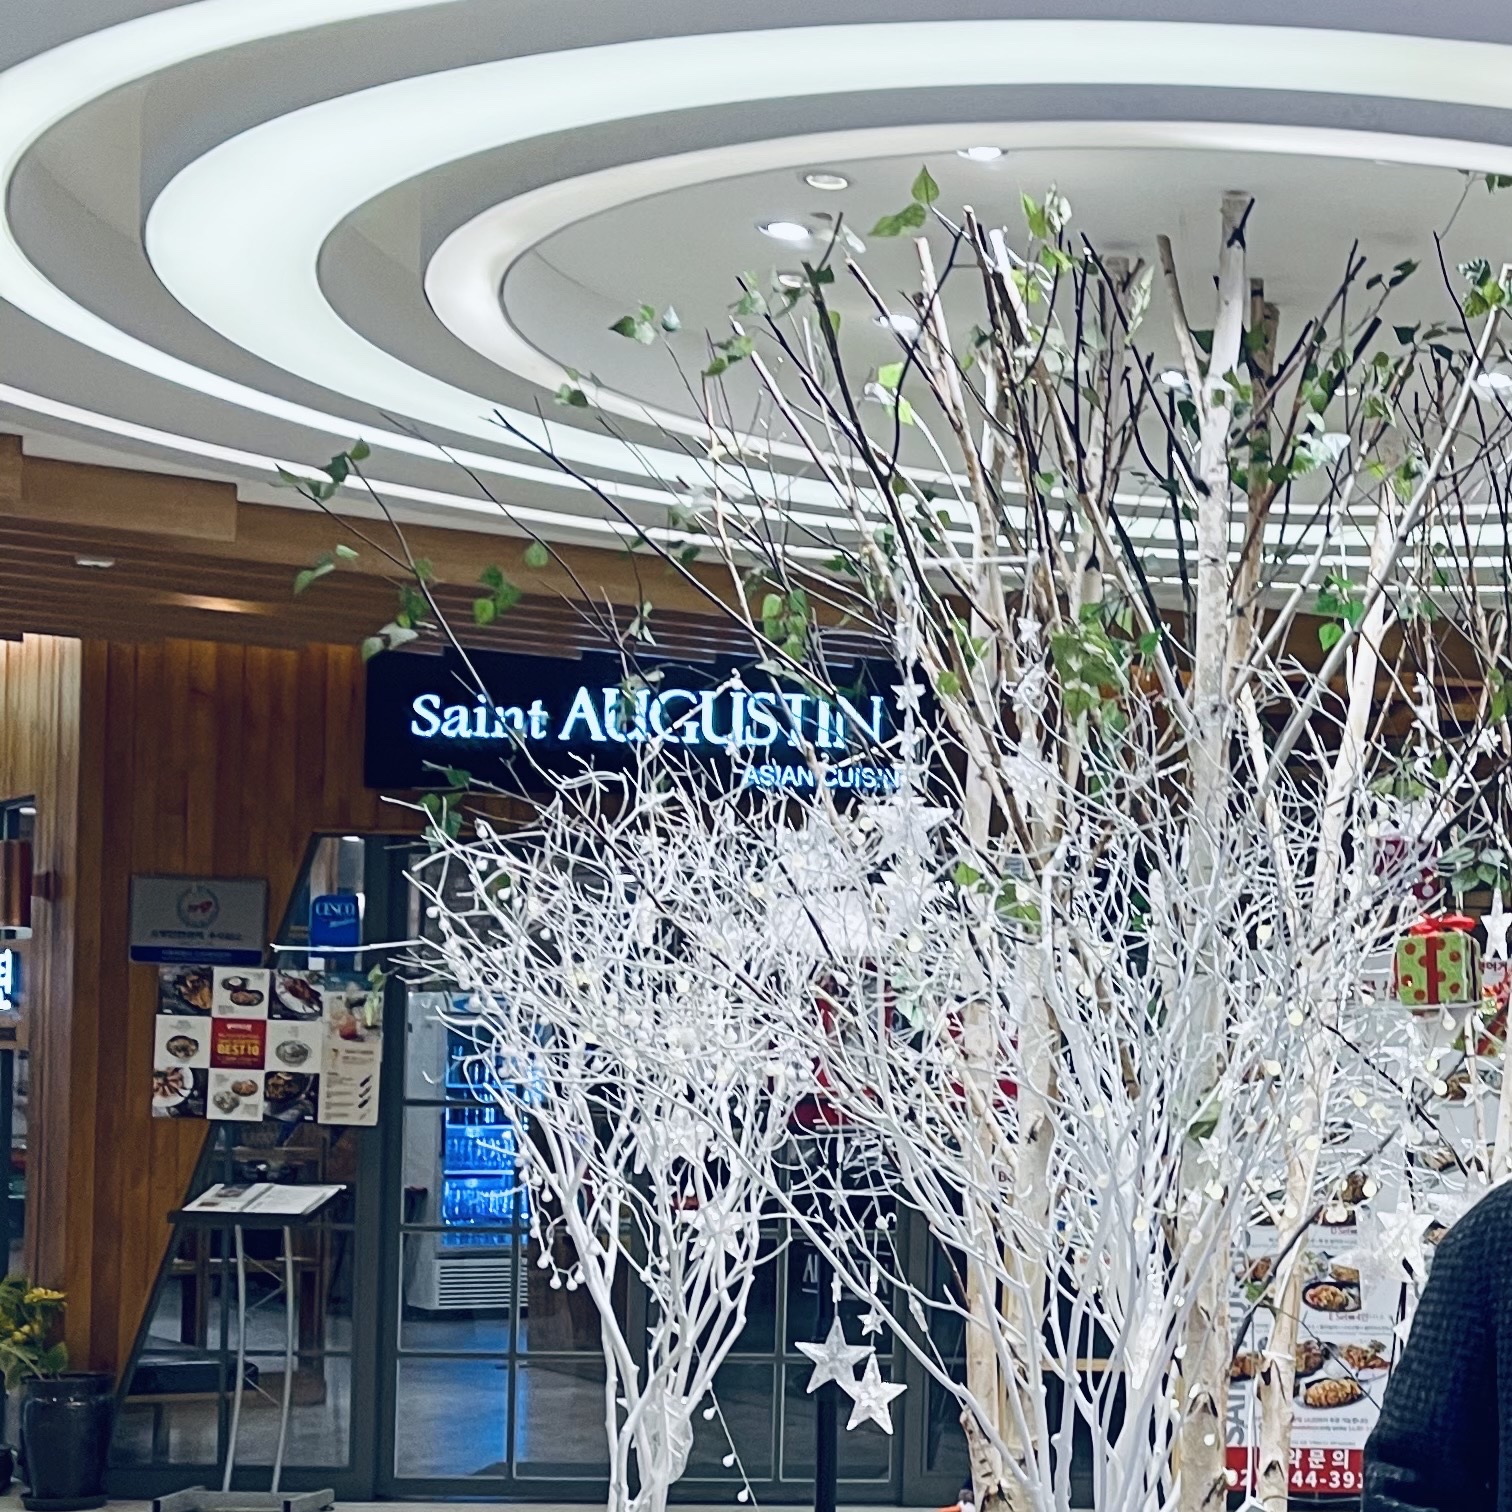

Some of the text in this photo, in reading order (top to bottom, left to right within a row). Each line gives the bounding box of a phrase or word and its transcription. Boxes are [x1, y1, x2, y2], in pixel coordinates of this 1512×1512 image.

[411, 686, 884, 749] Saint AUGUSTIN
[744, 764, 906, 790] ASIAN CUISIN
[1289, 1449, 1350, 1470] 약문의
